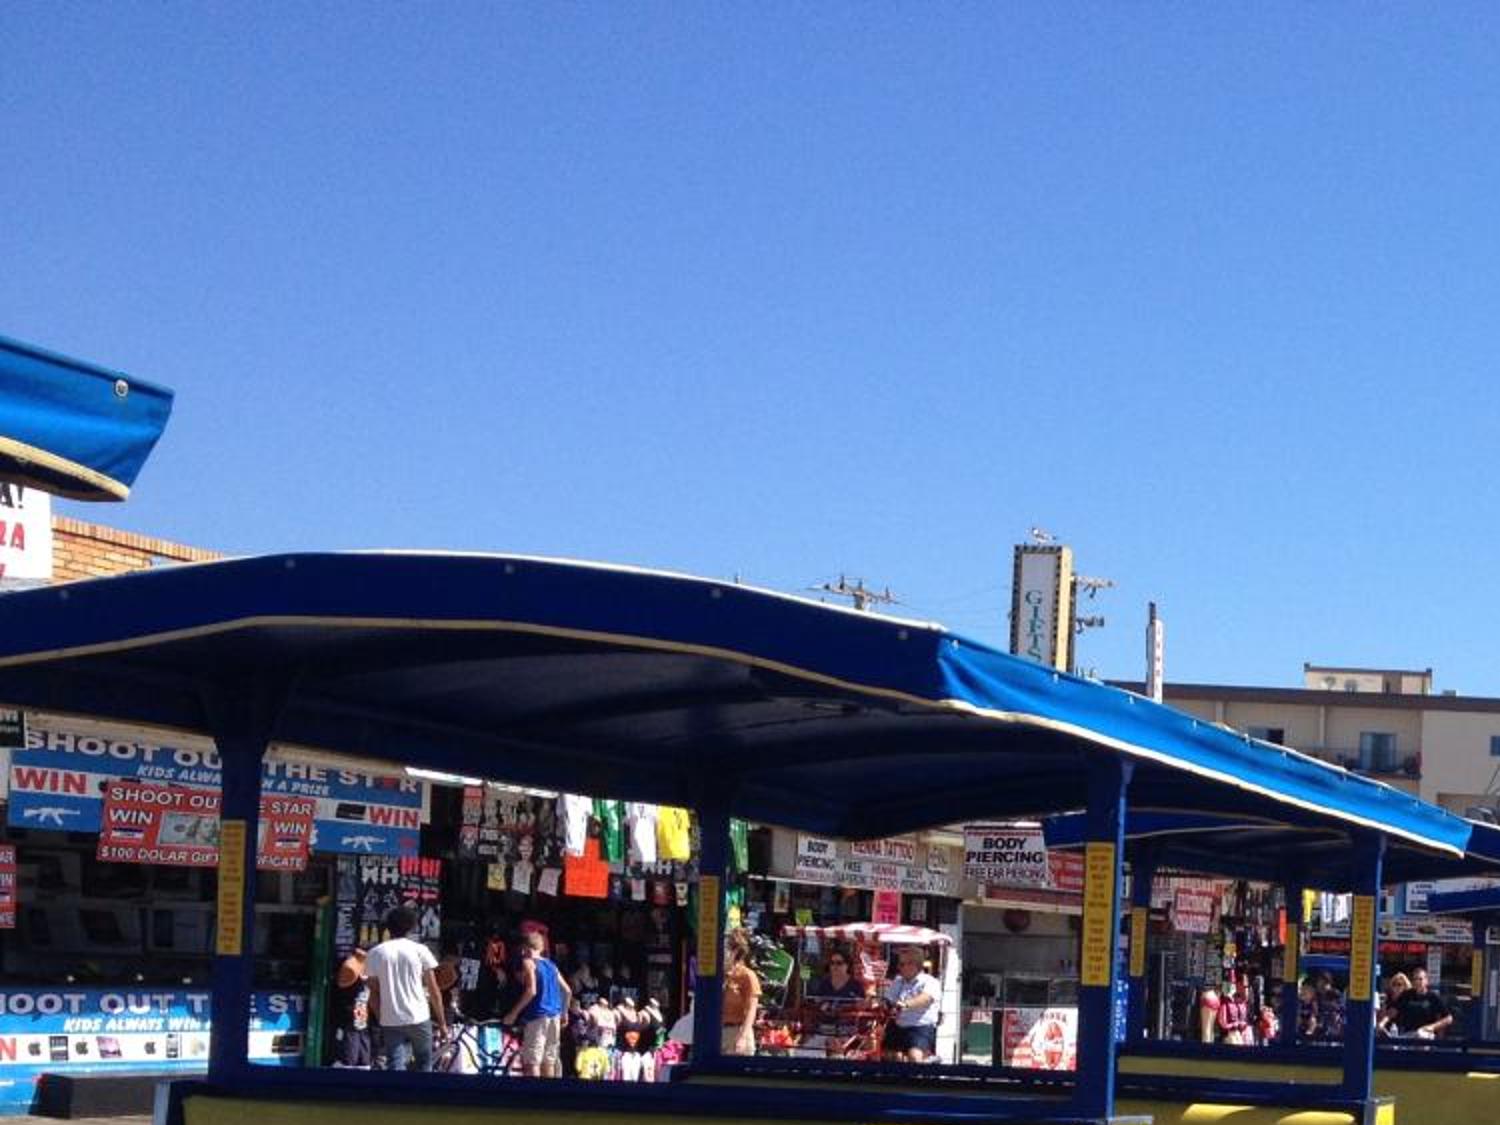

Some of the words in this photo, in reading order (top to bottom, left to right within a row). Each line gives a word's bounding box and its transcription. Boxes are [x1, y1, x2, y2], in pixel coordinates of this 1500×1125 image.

[26, 731, 160, 762] SHOOT
[173, 749, 223, 769] OU
[262, 761, 327, 783] THE
[14, 767, 87, 794] WIN
[136, 764, 174, 779] KIDS
[178, 769, 222, 784] ALWA
[110, 787, 184, 805] SHOOT
[189, 795, 219, 808] OU
[271, 802, 313, 815] STAR
[109, 808, 153, 824] WIN
[369, 805, 419, 828] WIN
[274, 821, 307, 834] WIN
[982, 837, 1026, 849] BODY
[965, 851, 1044, 863] PIERCING
[100, 993, 175, 1015] OUT
[63, 1017, 102, 1033] KIDS
[105, 1017, 164, 1032] ALWAYS
